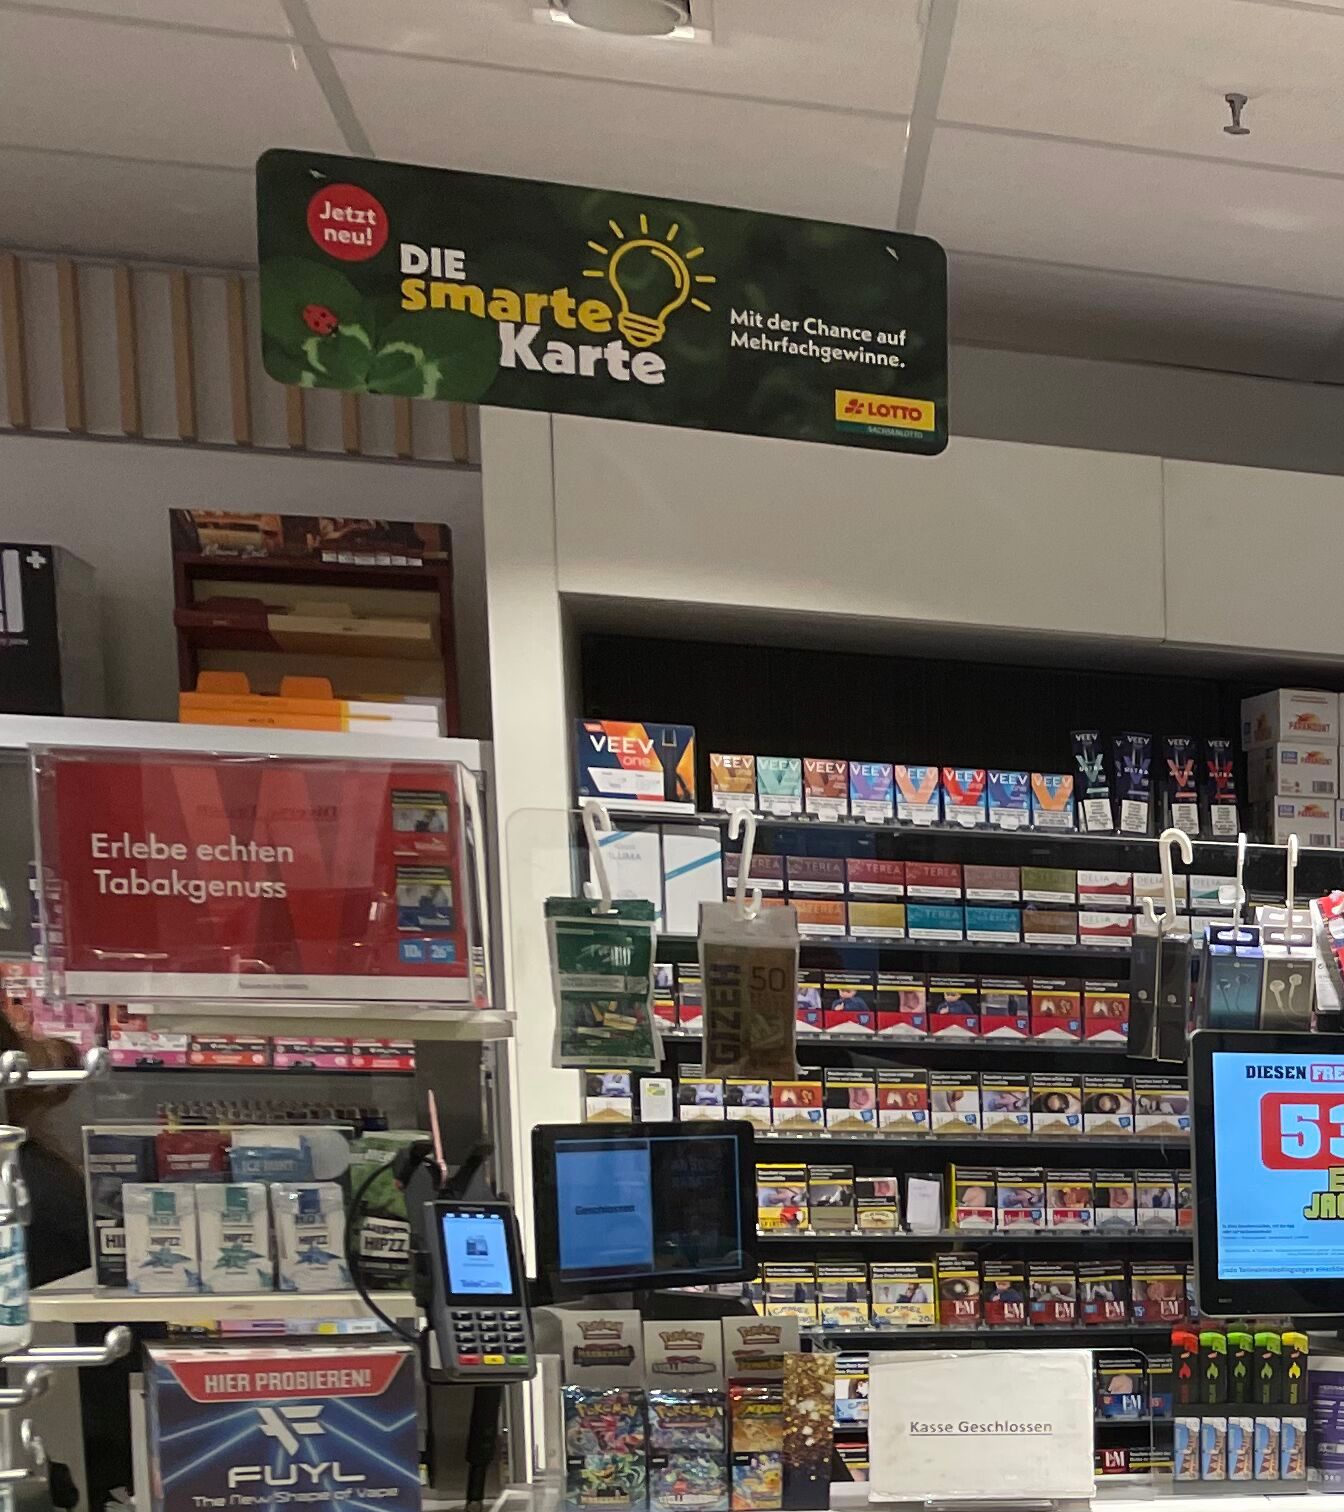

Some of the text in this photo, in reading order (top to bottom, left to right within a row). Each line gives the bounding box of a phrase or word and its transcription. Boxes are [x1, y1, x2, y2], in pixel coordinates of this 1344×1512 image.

[319, 201, 377, 225] Jetzt
[324, 227, 373, 246] neu!
[400, 243, 466, 280] DIE
[401, 278, 612, 333] smarte
[730, 308, 907, 347] Mit der Chance auf
[499, 321, 665, 385] Karte
[730, 331, 906, 369] Mehrfachgewinne.
[868, 401, 923, 422] LOTTO
[1288, 721, 1330, 733] PARAMOUNT
[589, 734, 655, 755] VEEV
[622, 756, 651, 767] one
[711, 755, 753, 768] VEEV
[759, 759, 800, 772] VEEV
[805, 762, 846, 774] VEEV
[852, 764, 891, 777] VEEV
[945, 770, 984, 782] VEEV
[989, 773, 1028, 785] VEEV
[91, 833, 293, 863] Erlebe echten
[94, 869, 287, 903] Tabakgenuss
[749, 966, 786, 992] 50
[1246, 1065, 1306, 1080] DIESEN
[205, 1369, 372, 1393] HIER PROBIEREN!
[910, 1419, 1053, 1434] Kasse Geschlossen
[228, 1463, 365, 1486] FUYL
[192, 1486, 399, 1508] The New Shape Vape
